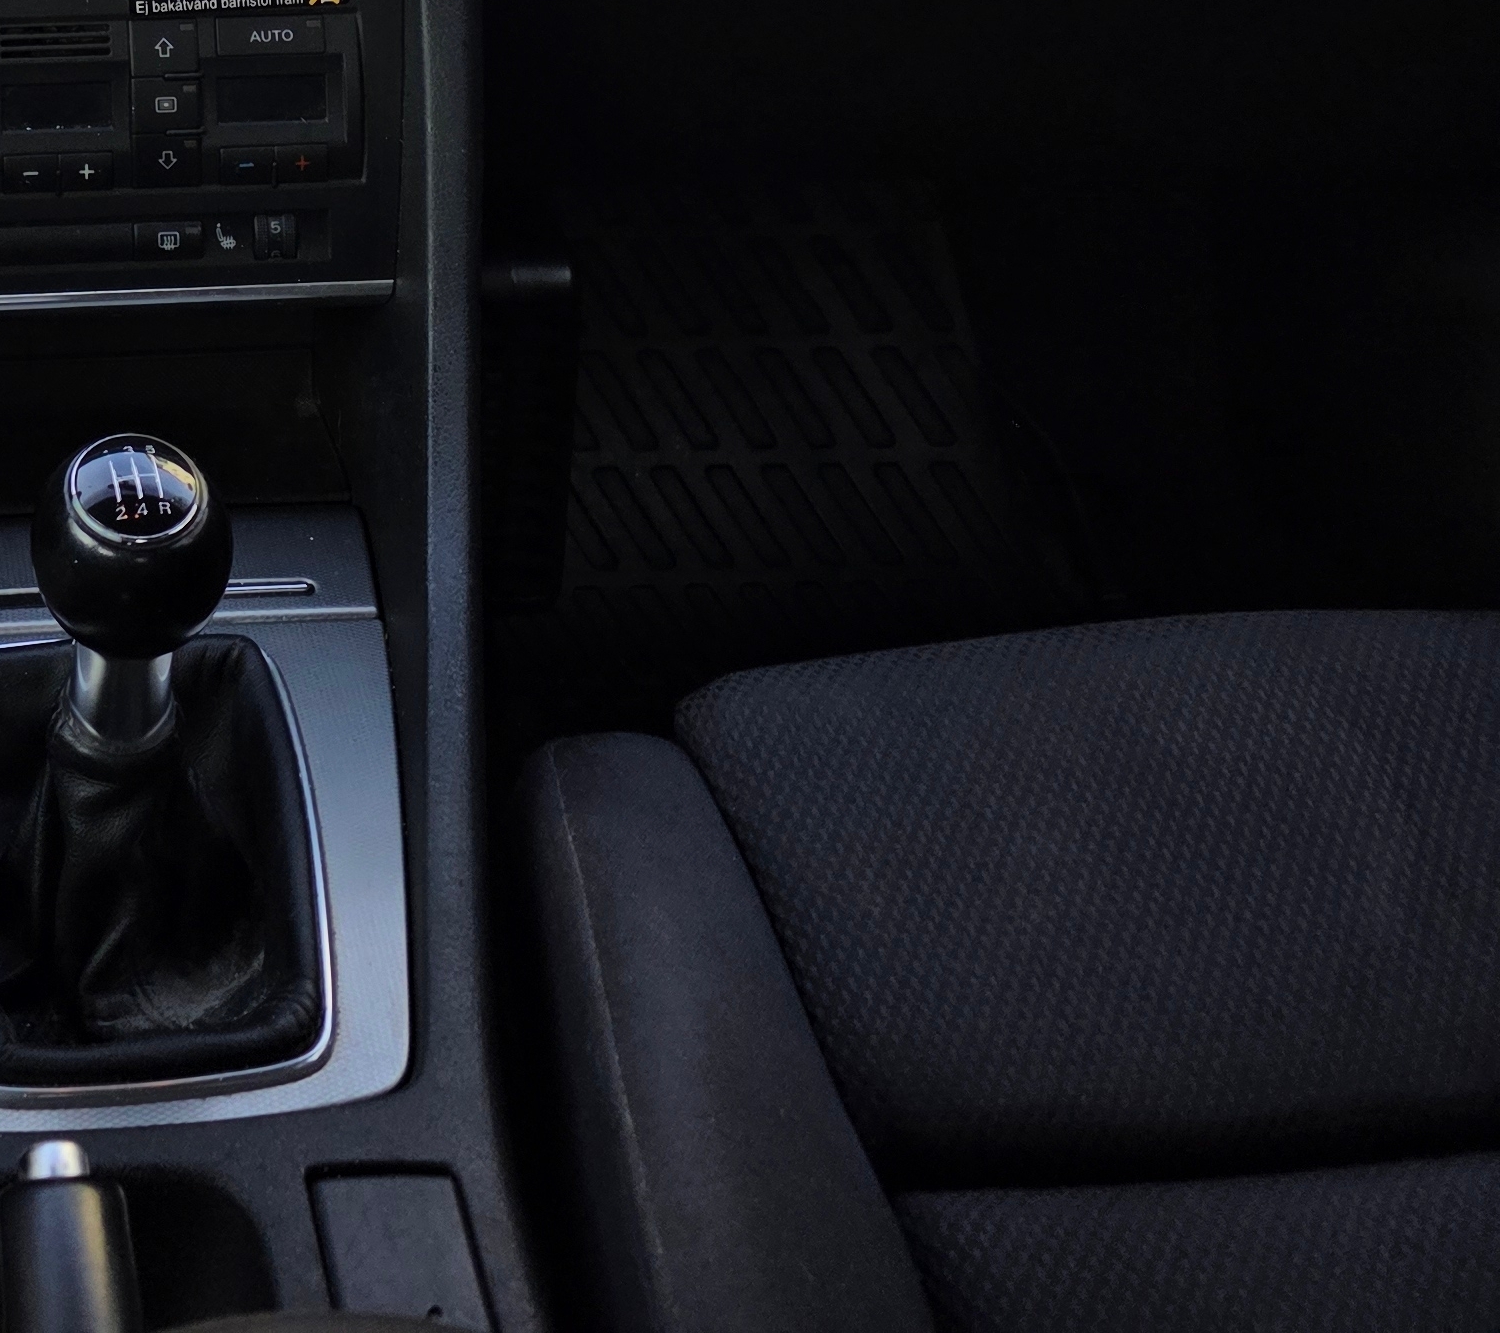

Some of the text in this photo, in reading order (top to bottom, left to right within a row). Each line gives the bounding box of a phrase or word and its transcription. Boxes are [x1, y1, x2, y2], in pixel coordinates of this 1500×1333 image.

[135, 0, 149, 15] Ej
[249, 29, 294, 43] AUTO
[269, 221, 281, 234] 5
[115, 506, 128, 521] 2
[158, 501, 172, 515] R
